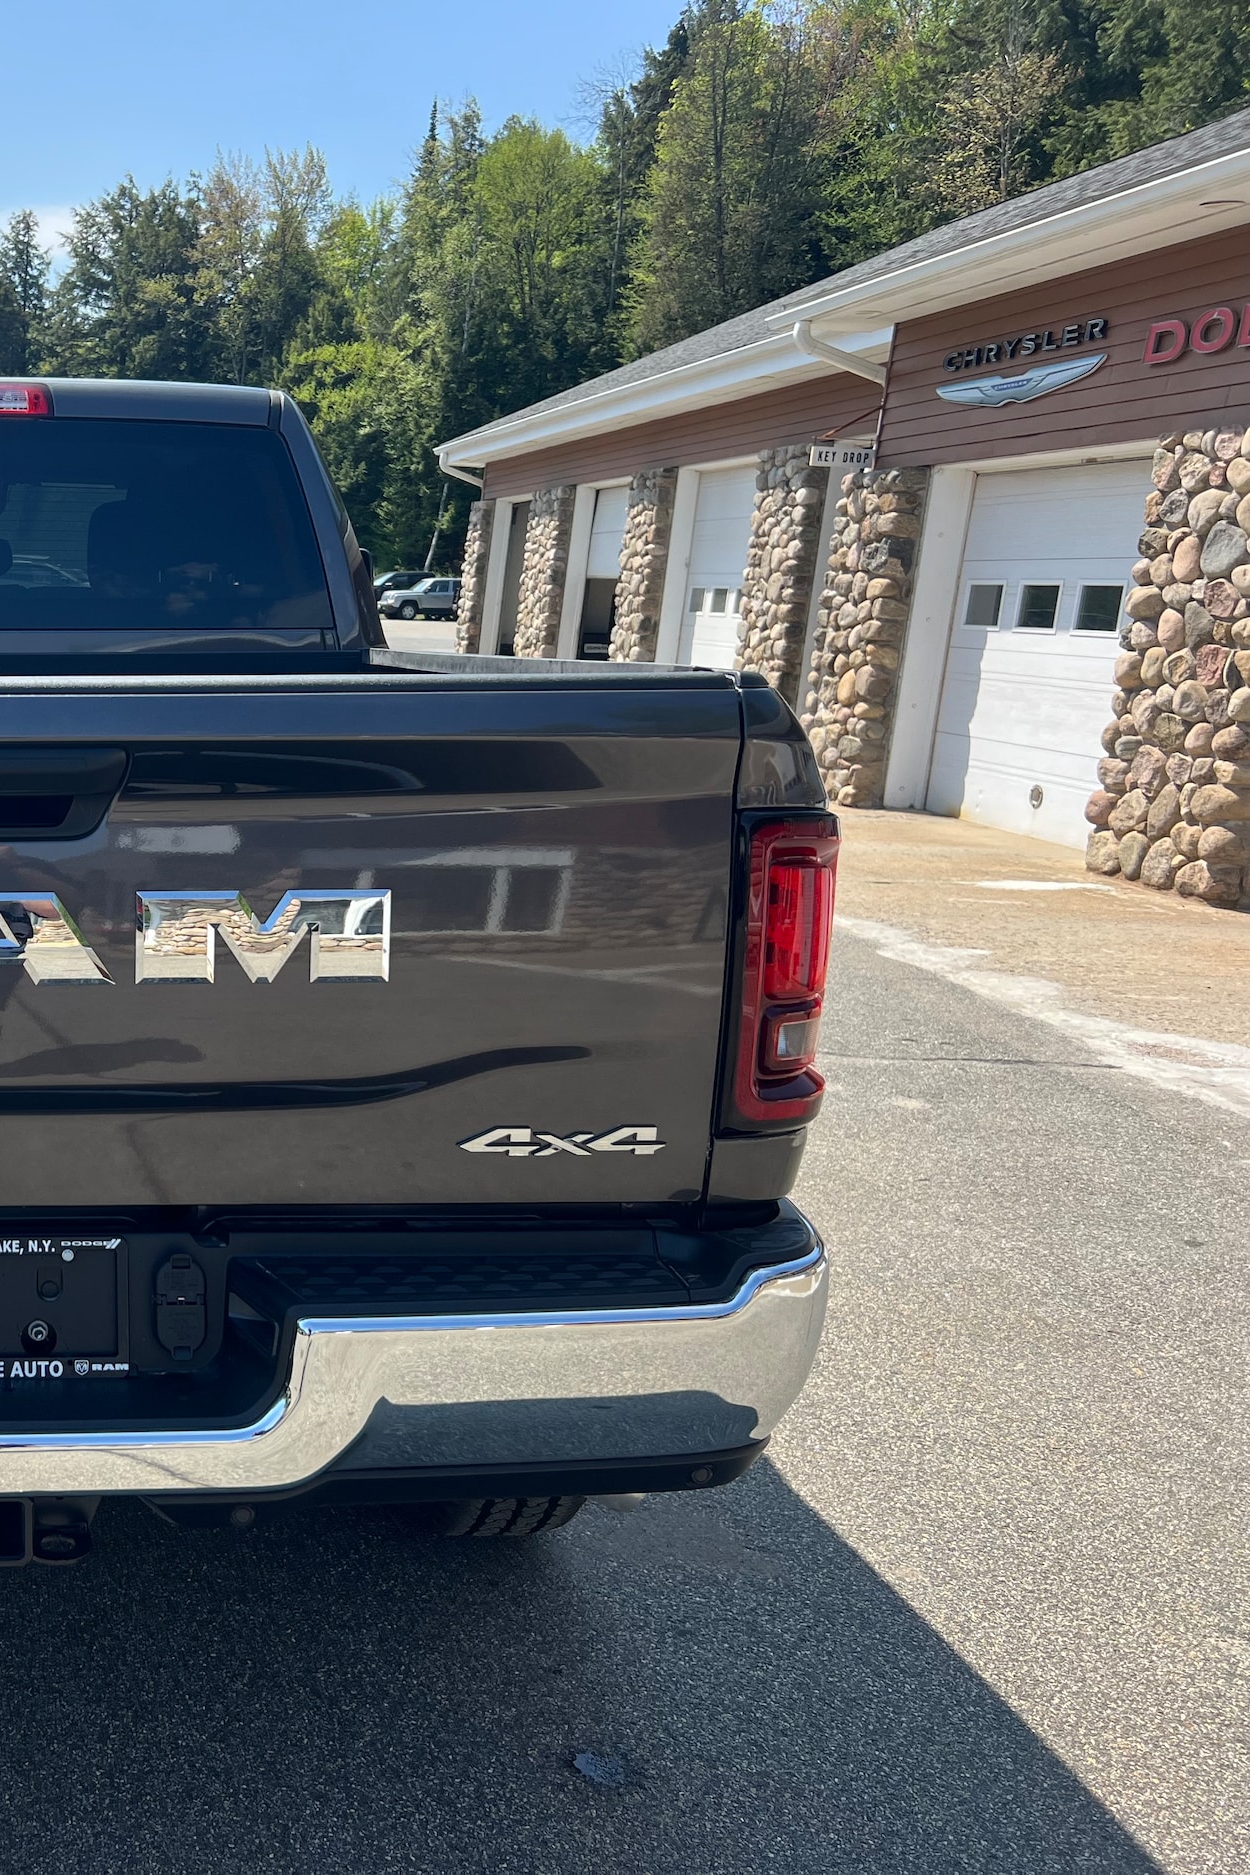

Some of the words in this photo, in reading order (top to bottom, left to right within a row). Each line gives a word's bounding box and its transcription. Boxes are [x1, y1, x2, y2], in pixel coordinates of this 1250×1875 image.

[942, 317, 1108, 372] CHRYSLER
[817, 450, 837, 462] KEY
[842, 451, 869, 463] DROP
[456, 1124, 667, 1156] 4x4
[28, 1240, 56, 1253] N.Y.
[10, 1360, 63, 1378] AUTO
[91, 1363, 130, 1371] RAM
